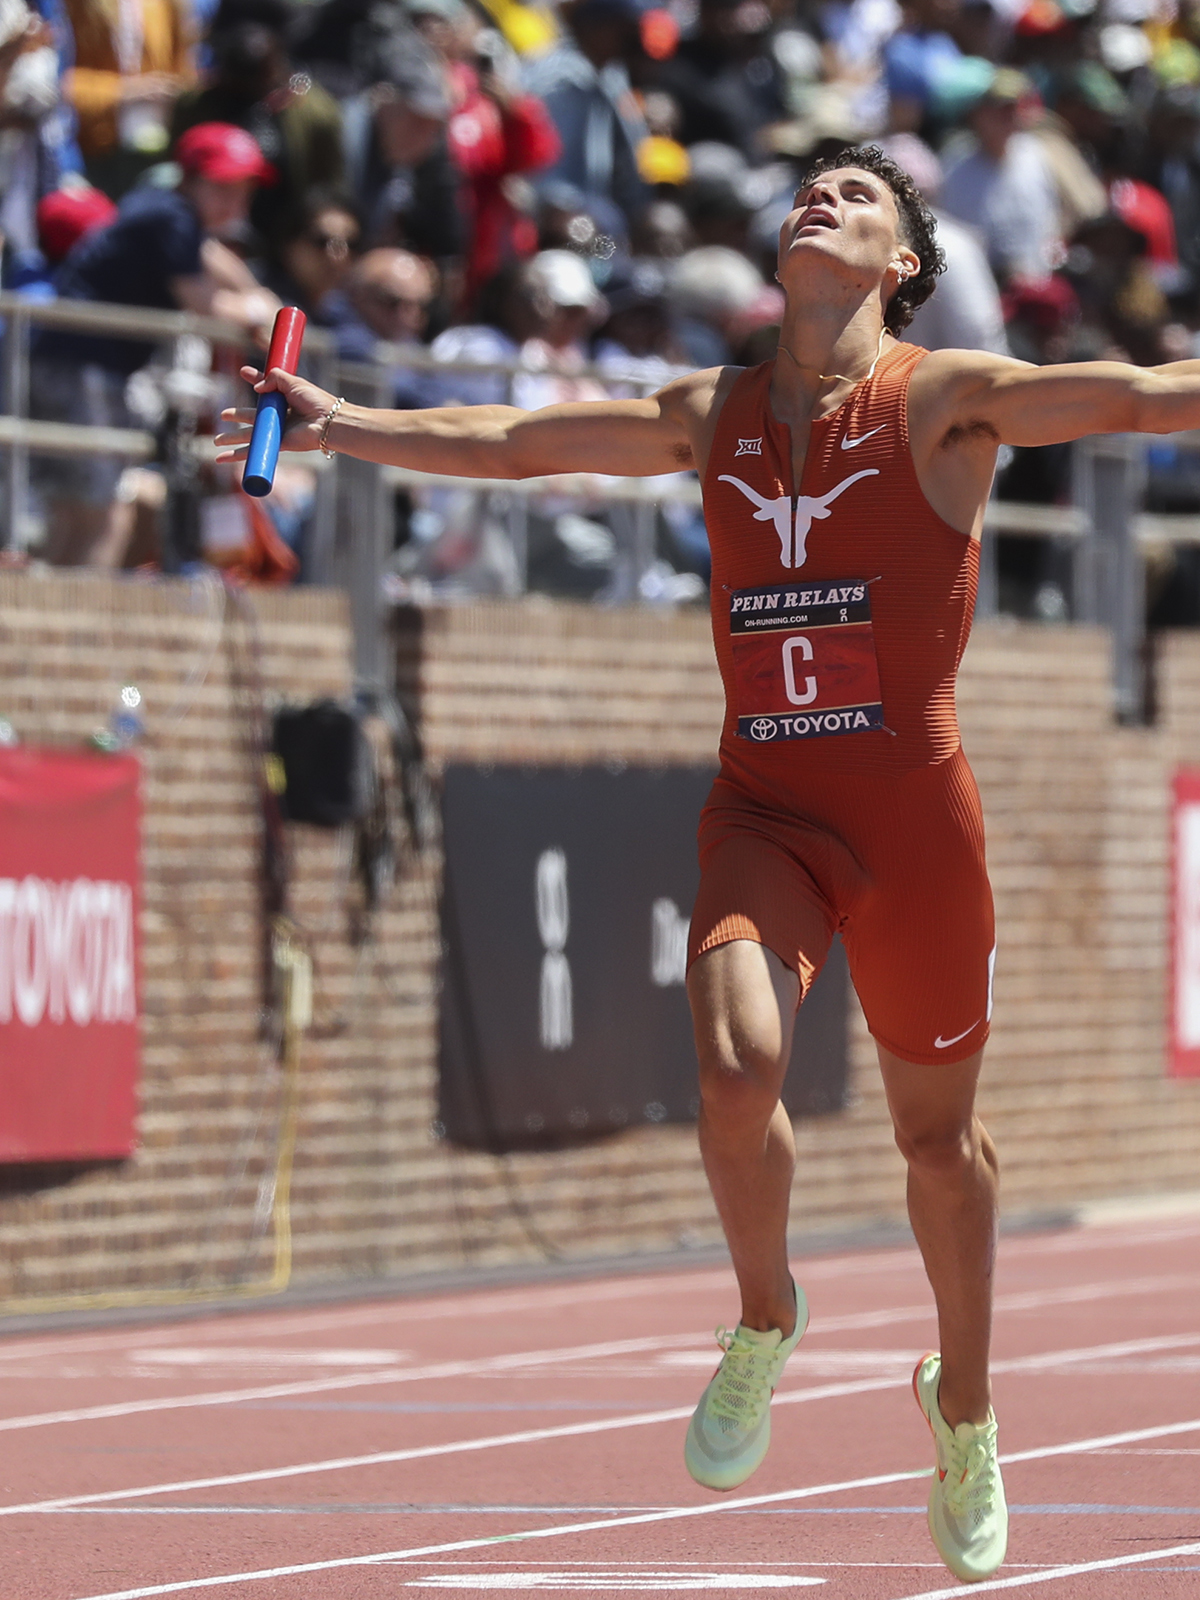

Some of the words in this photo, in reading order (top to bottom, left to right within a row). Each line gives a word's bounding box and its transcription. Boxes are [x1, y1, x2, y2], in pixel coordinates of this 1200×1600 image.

[731, 592, 781, 613] PENN
[783, 585, 865, 608] RELAYS
[744, 615, 808, 627] ON-RUNNING.COM
[782, 636, 818, 706] C
[780, 710, 870, 736] TOYOTA
